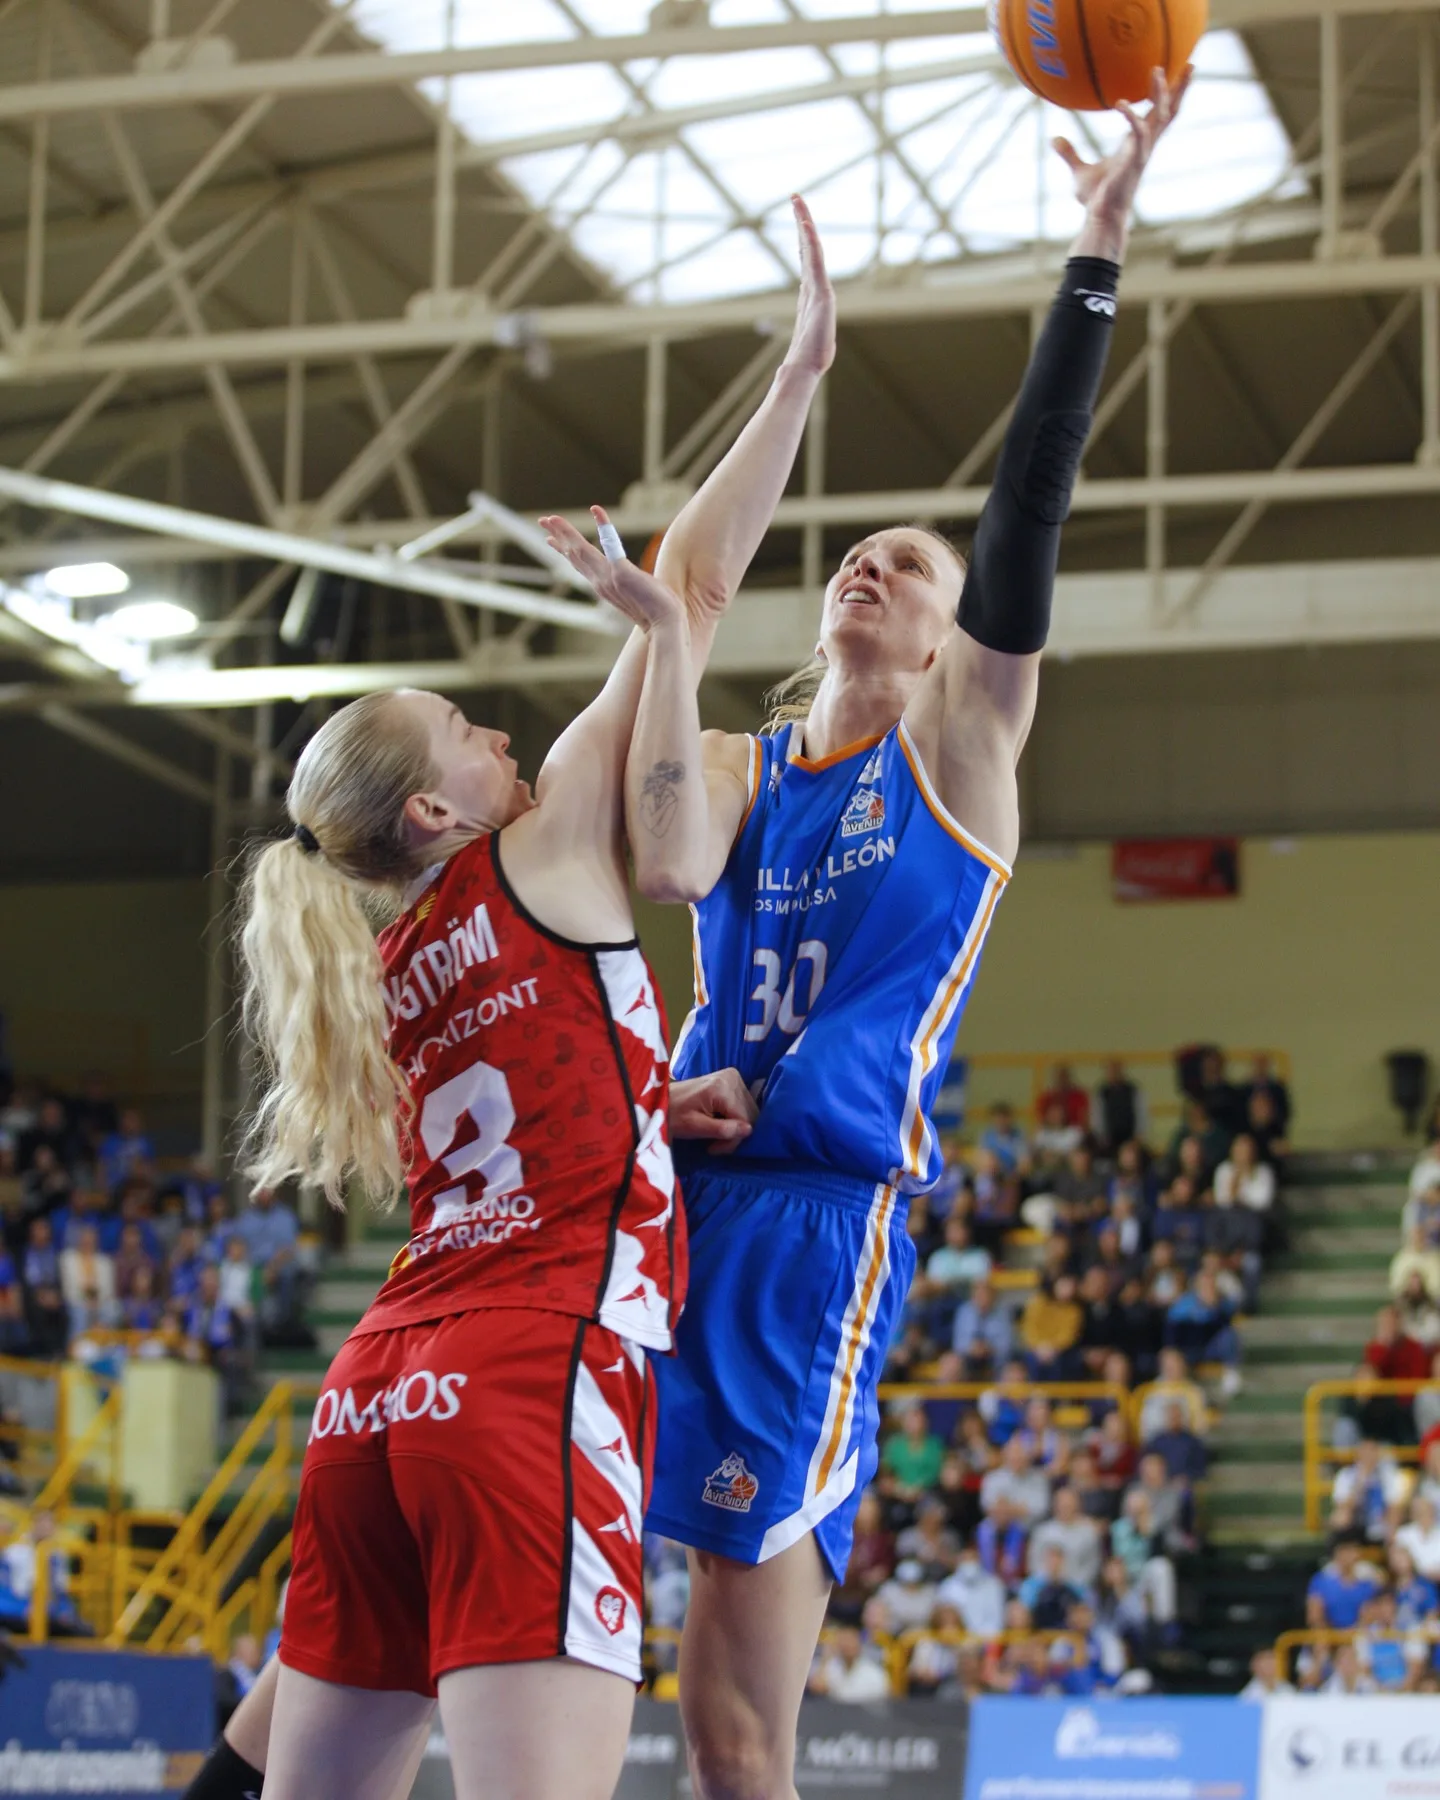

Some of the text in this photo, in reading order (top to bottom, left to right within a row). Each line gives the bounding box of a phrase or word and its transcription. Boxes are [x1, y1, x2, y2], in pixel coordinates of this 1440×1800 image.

[844, 816, 884, 834] AVENID
[827, 837, 896, 879] LEÓN
[775, 886, 837, 915] IMPUSA
[744, 939, 828, 1041] 30
[420, 1060, 524, 1232] 3
[706, 1489, 748, 1509] AVENIDA
